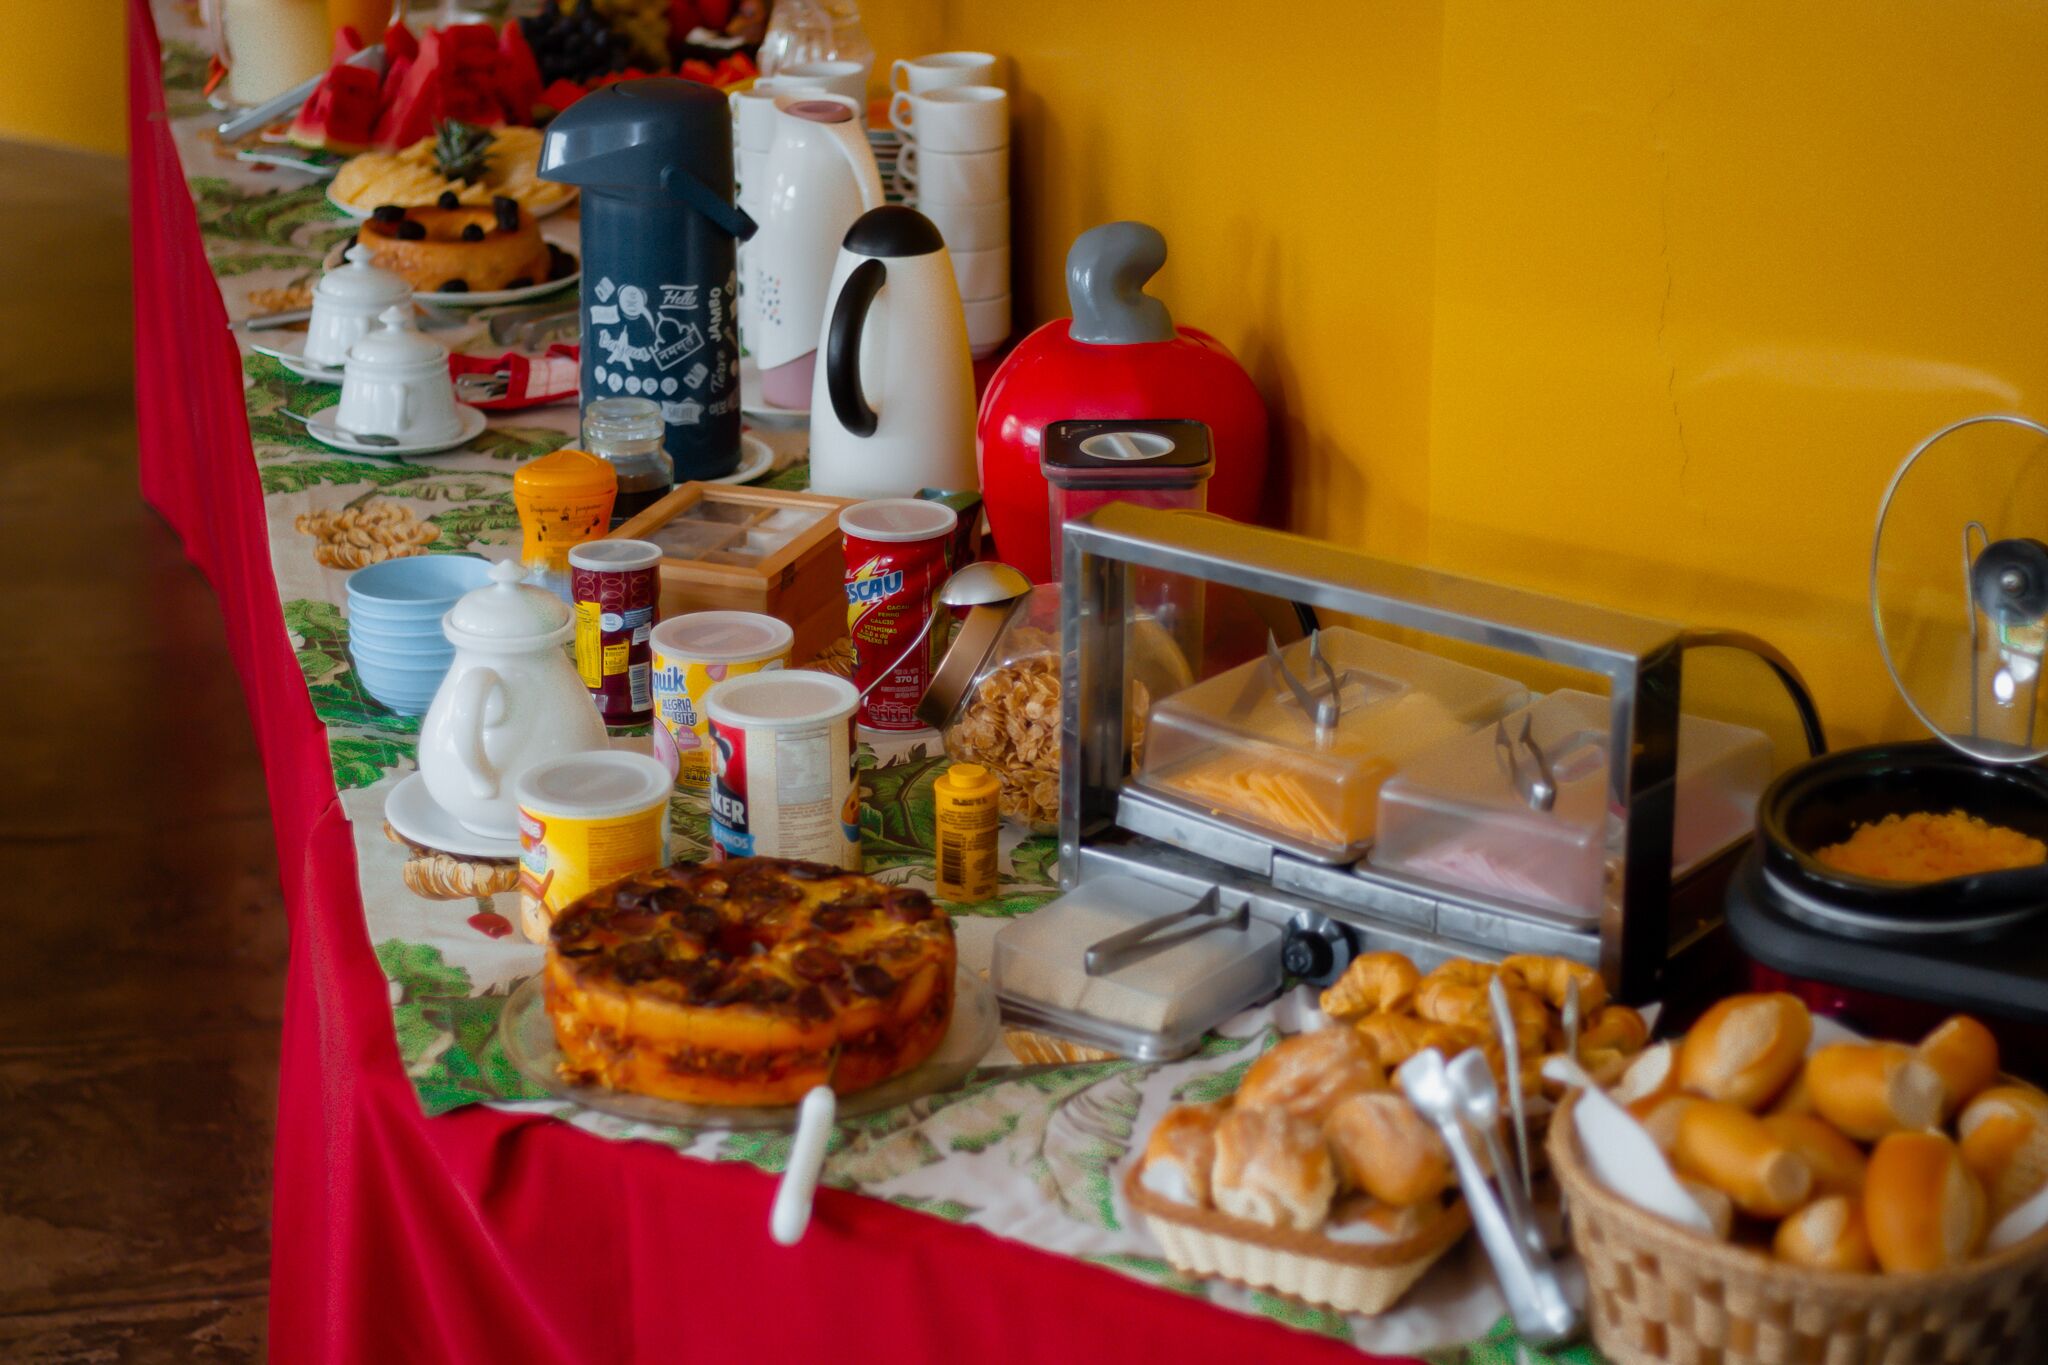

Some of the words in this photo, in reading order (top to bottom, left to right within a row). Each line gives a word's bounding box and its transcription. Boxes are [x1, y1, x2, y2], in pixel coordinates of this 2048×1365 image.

[663, 290, 697, 306] Hello
[708, 287, 722, 342] JAMBO
[895, 675, 913, 684] 370
[662, 698, 692, 711] ALEGRIA
